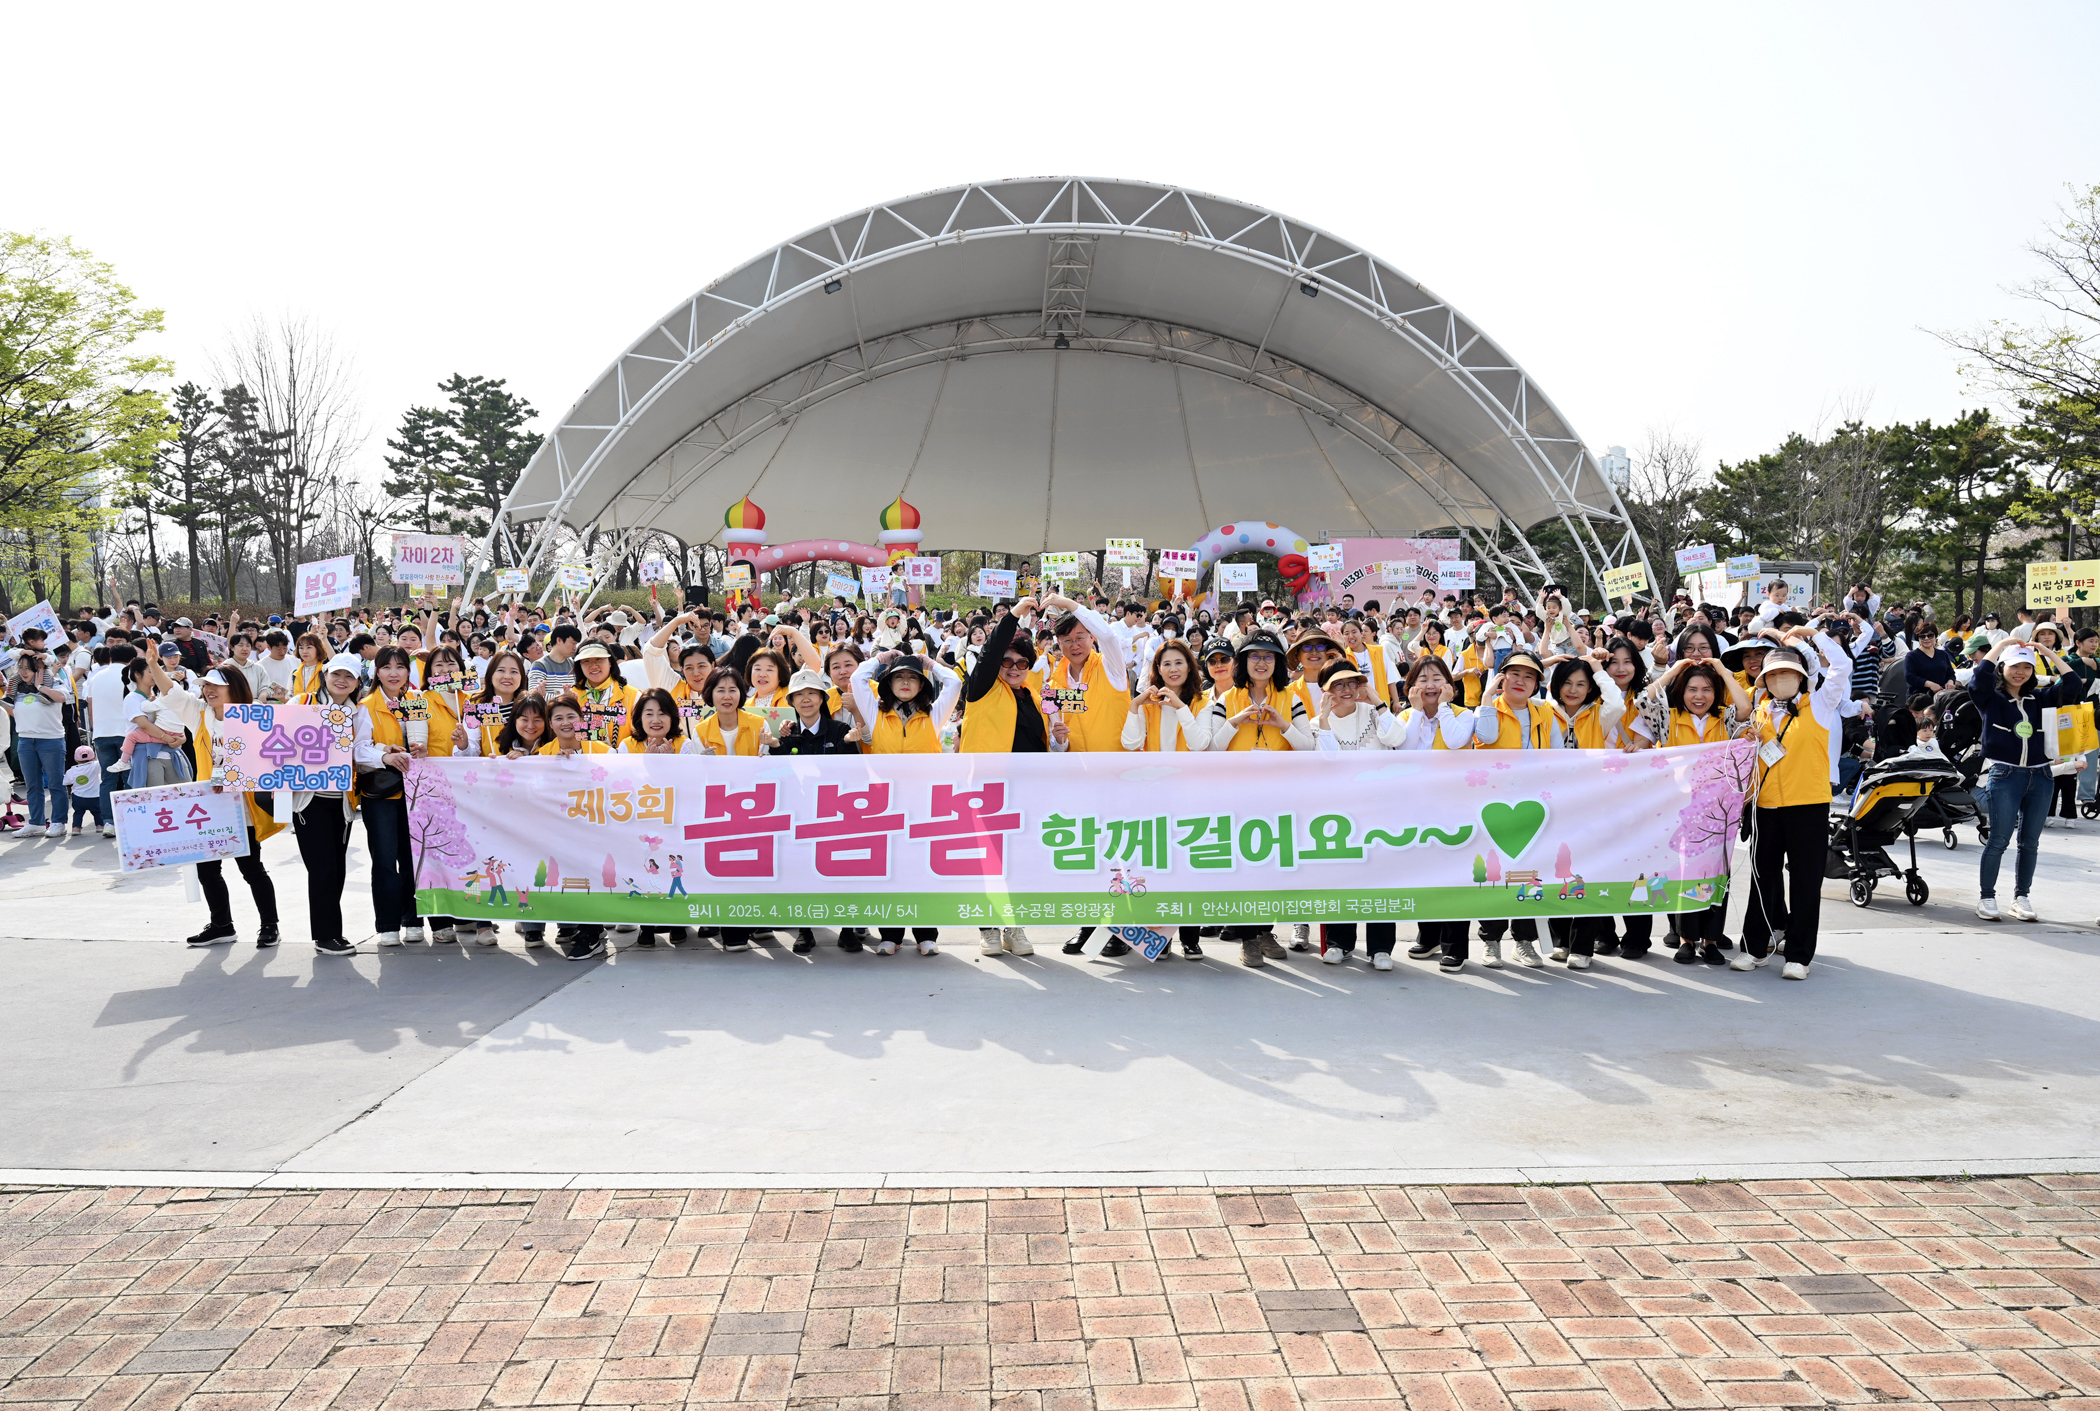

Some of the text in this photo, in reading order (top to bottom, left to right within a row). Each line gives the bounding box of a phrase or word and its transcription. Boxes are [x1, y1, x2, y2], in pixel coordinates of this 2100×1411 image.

[401, 547, 455, 564] 자이 2차
[870, 574, 887, 583] 호수
[912, 563, 933, 577] 본오
[305, 571, 337, 600] 본오
[1340, 568, 1365, 590] 제3회
[2033, 593, 2075, 605] 어린이집
[1041, 689, 1083, 700] 우리 원장님
[400, 699, 427, 710] 어린이집
[1061, 699, 1085, 713] 최고
[225, 704, 274, 732] 시립
[408, 709, 427, 721] 최고
[481, 713, 503, 726] 최고
[259, 723, 336, 768] 수암
[259, 764, 352, 791] 어린이집
[127, 805, 147, 815] 시립
[153, 803, 211, 834] 호수
[198, 826, 233, 836] 어린이집
[566, 783, 675, 825] 제3회
[683, 781, 1021, 878] 봄봄봄
[145, 838, 228, 858] 완주하면 저녁은 꿀맛!
[687, 903, 713, 919] 일시
[728, 904, 765, 918] 2025.
[769, 904, 782, 918] 4.
[787, 903, 830, 920] 18.(금)
[833, 903, 860, 919] 오후
[896, 903, 919, 919] 5시
[957, 902, 1116, 919] 장소 호수공원 중앙광장
[1155, 897, 1417, 918] 주최 안산시어린이집연합회 국공립분과
[1107, 926, 1168, 960] 이집
